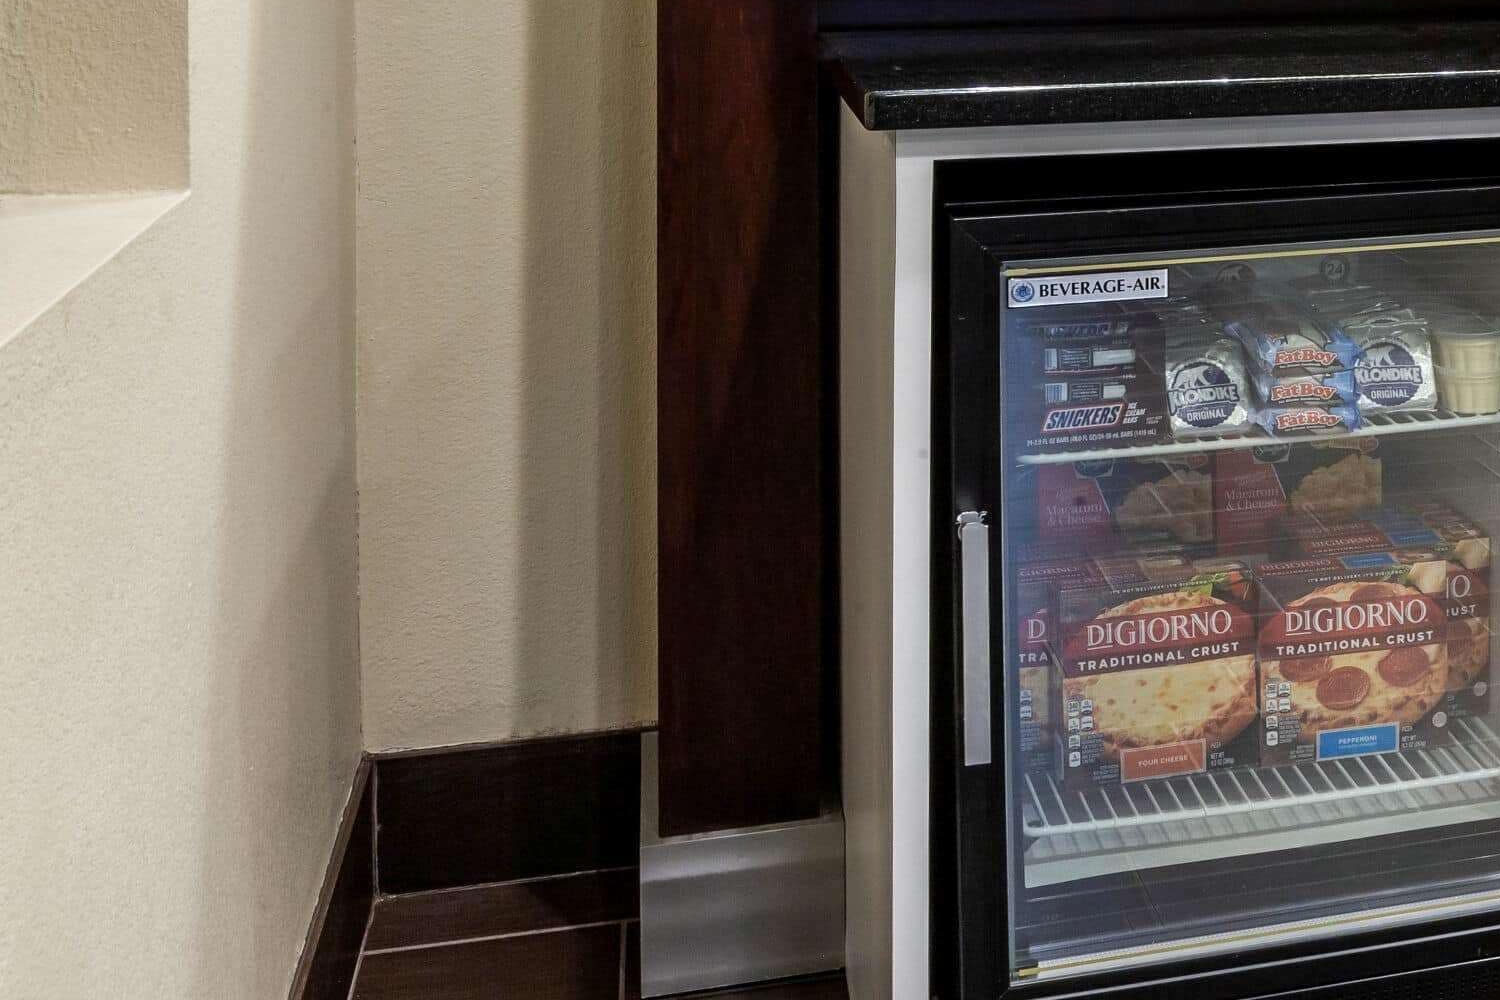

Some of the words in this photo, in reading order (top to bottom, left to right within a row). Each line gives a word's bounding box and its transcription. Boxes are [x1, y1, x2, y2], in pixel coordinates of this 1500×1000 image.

[1039, 276, 1161, 298] BEVERAGE-AIR
[1354, 366, 1423, 384] KLONDIKE
[1168, 384, 1239, 415] KLONDIKE
[1370, 388, 1410, 400] ORIGINAL
[1046, 405, 1120, 430] SNICKERS
[1186, 407, 1227, 422] ORIGINAL
[1276, 636, 1380, 656] TRADITIONAL
[1386, 630, 1435, 645] CRUST
[1077, 650, 1185, 672] TRADITIONAL
[1191, 641, 1240, 658] CRUST
[1338, 734, 1378, 745] PEPPERONI
[1138, 758, 1158, 768] FOUR
[1160, 754, 1189, 766] CHEESE
